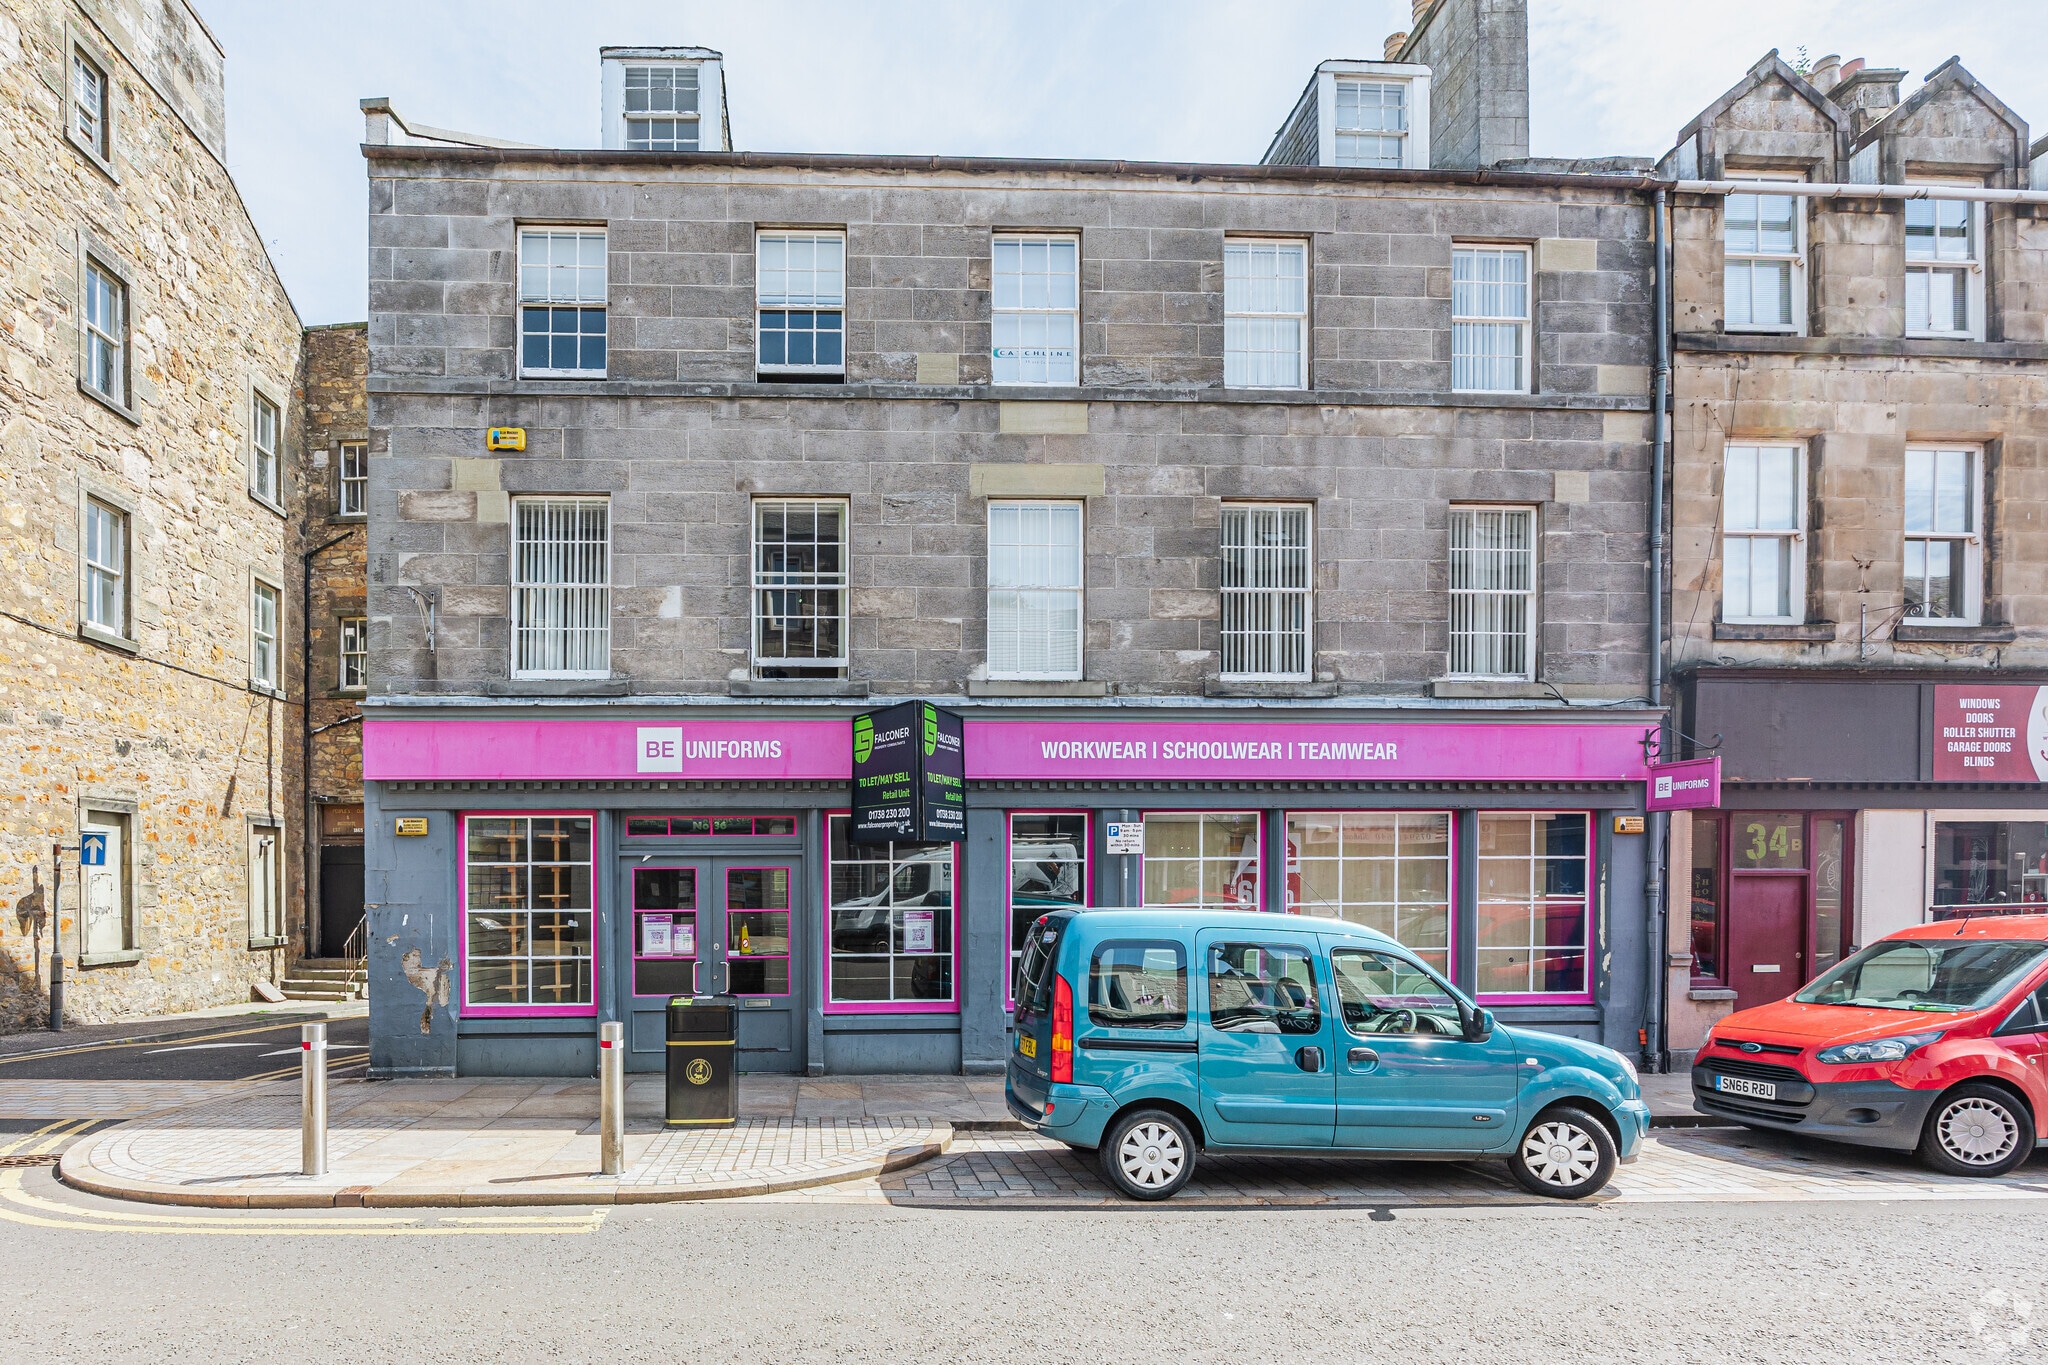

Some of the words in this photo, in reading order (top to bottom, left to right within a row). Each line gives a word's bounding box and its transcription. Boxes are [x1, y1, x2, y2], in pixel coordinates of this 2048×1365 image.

[1959, 698, 2001, 709] WINDOWS
[1965, 712, 1994, 723] DOORS
[874, 727, 910, 744] FALCONER
[1943, 727, 1976, 738] ROLLER
[1977, 727, 2016, 738] SHUTTER
[937, 731, 961, 748] FALCONER
[646, 741, 675, 758] BE
[685, 740, 782, 759] UNIFORMS
[1041, 741, 1147, 759] WORKWEAR
[1162, 741, 1282, 760] SCHOOLWEAR
[1297, 742, 1398, 760] TEAMWEAR
[1947, 741, 1982, 752] GARAGE
[1983, 741, 2011, 752] DOORS
[1963, 756, 1995, 767] BLINDS
[859, 777, 867, 788] TO
[867, 773, 893, 787] LET/MAY
[894, 771, 911, 783] SELL
[927, 771, 934, 782] TO
[952, 777, 963, 788] SELL
[1658, 782, 1669, 791] BE
[1672, 778, 1709, 791] UNIFORMS
[882, 789, 897, 800] Retail
[898, 788, 911, 798] Unit
[868, 809, 885, 820] 01738
[886, 808, 897, 818] 230
[898, 807, 911, 818] 200
[692, 821, 710, 830] No
[714, 821, 727, 830] 36
[1110, 826, 1118, 836] P
[1745, 823, 1789, 860] 34
[1791, 838, 1802, 851] B
[1722, 1077, 1749, 1093] SN66
[1751, 1082, 1773, 1097] RBU
